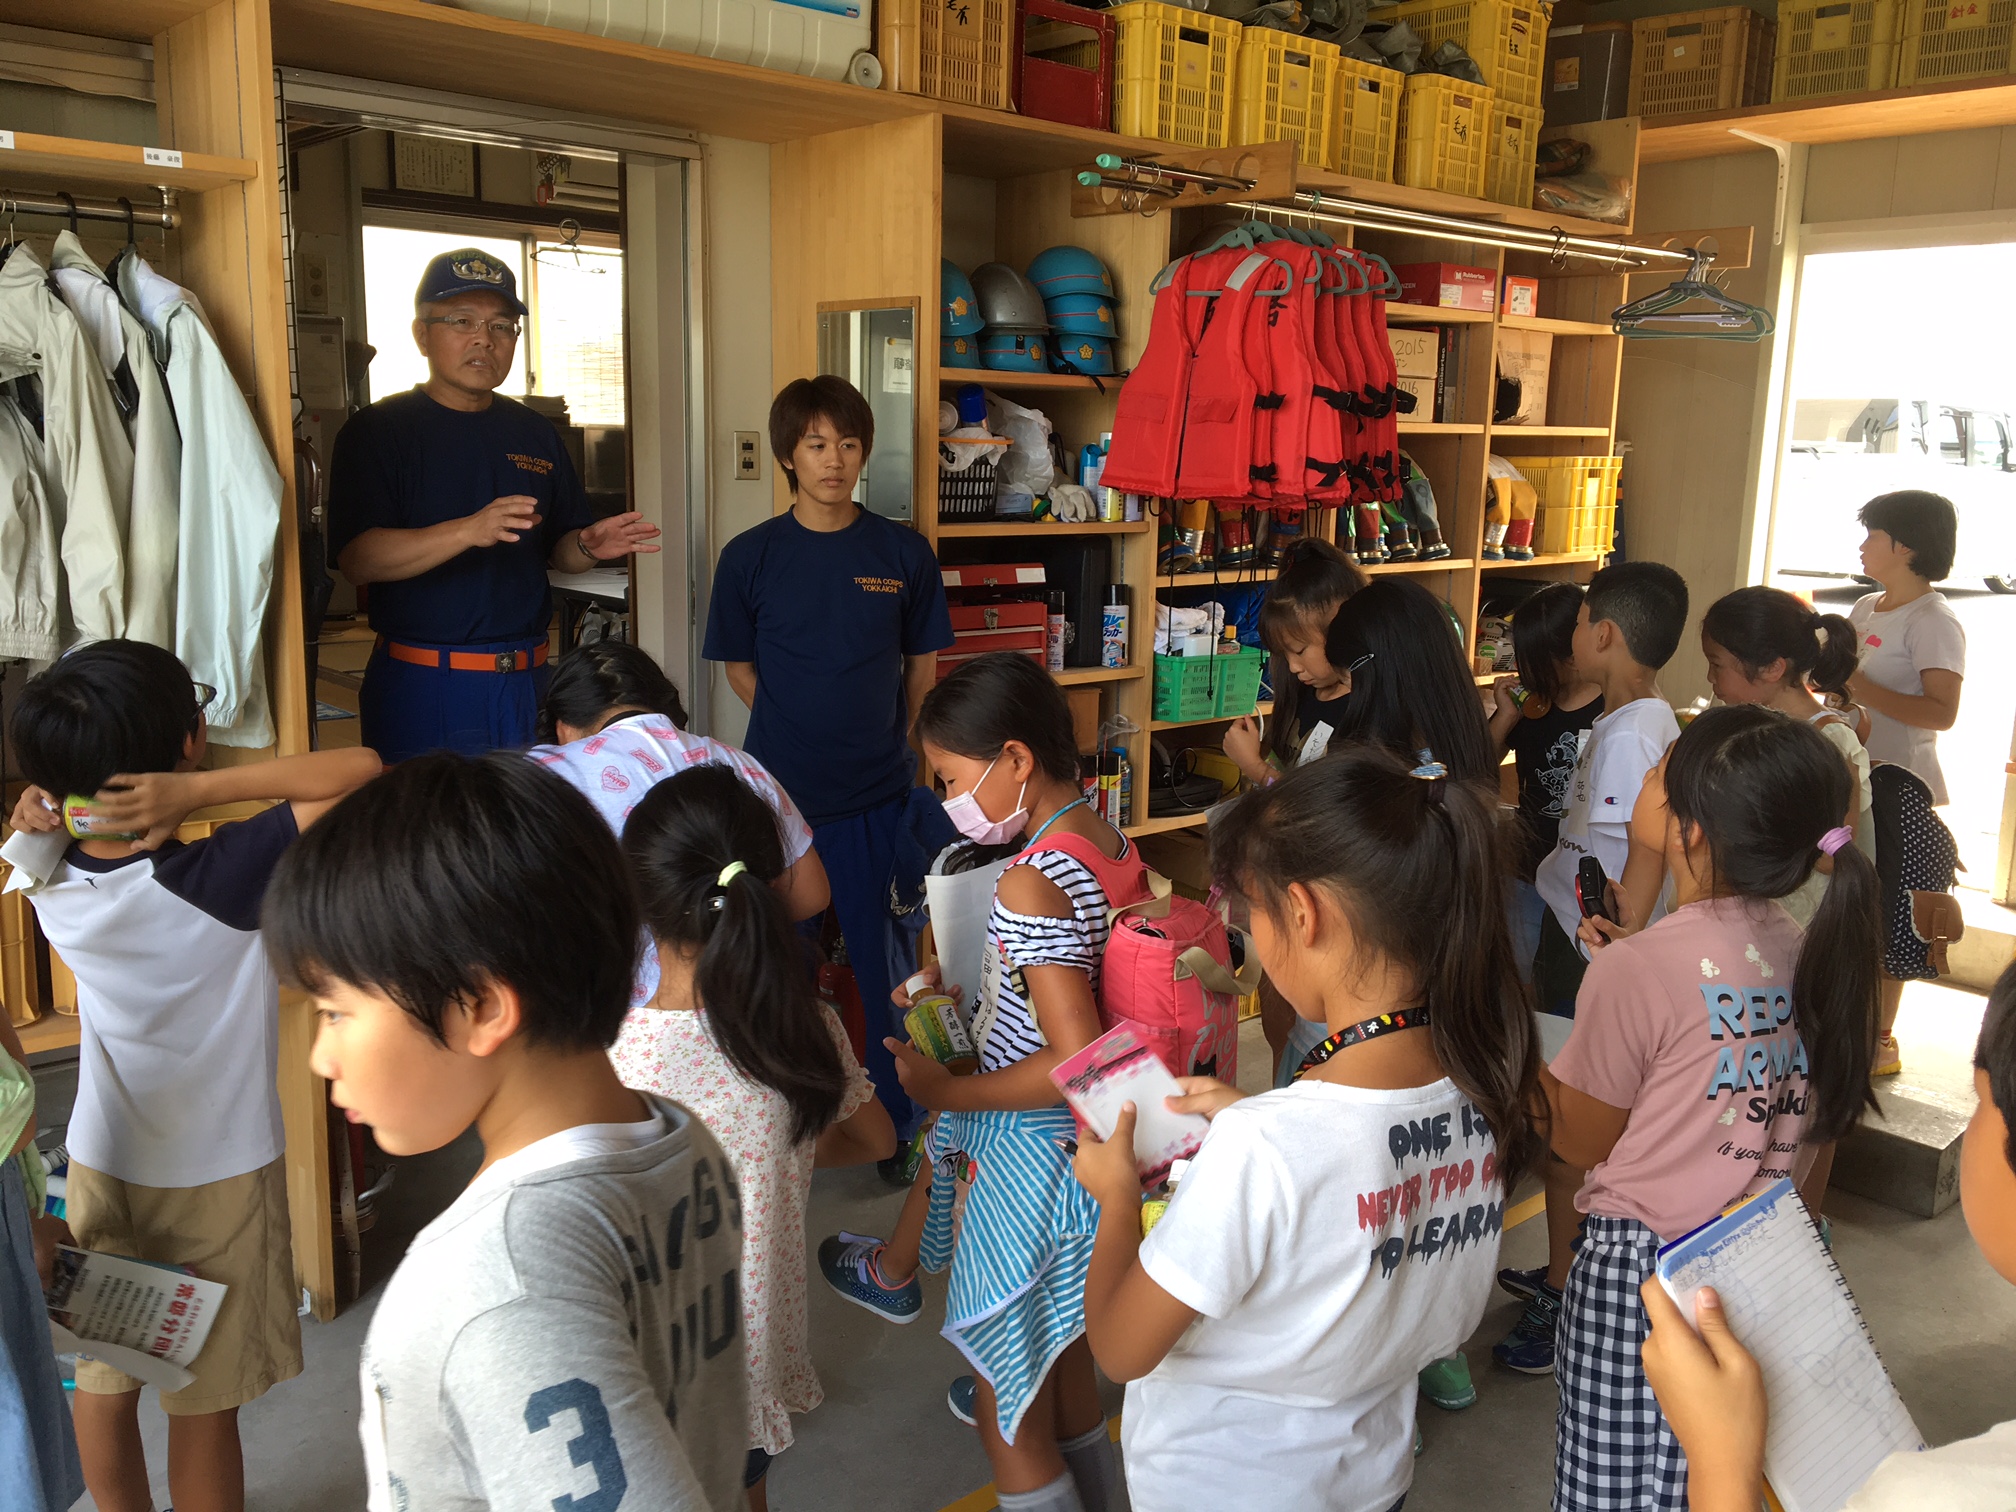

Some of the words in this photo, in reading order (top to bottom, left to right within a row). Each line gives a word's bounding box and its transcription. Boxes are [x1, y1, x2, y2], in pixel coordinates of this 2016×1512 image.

[1395, 337, 1427, 356] 2015
[505, 453, 533, 463] TOKIWA
[853, 577, 882, 585] TOKIWA
[882, 578, 904, 588] CORPS
[862, 584, 898, 594] YOKKAICHI
[1699, 983, 1798, 1041] REP
[1388, 1112, 1452, 1171] ONE
[1461, 1103, 1491, 1149] IS
[1734, 1146, 1763, 1161] you
[1768, 1138, 1798, 1153] have
[1357, 1173, 1423, 1237] NEVER
[1429, 1158, 1474, 1213] TOO
[1406, 1199, 1505, 1266] LEARN
[523, 1377, 628, 1512] 3
